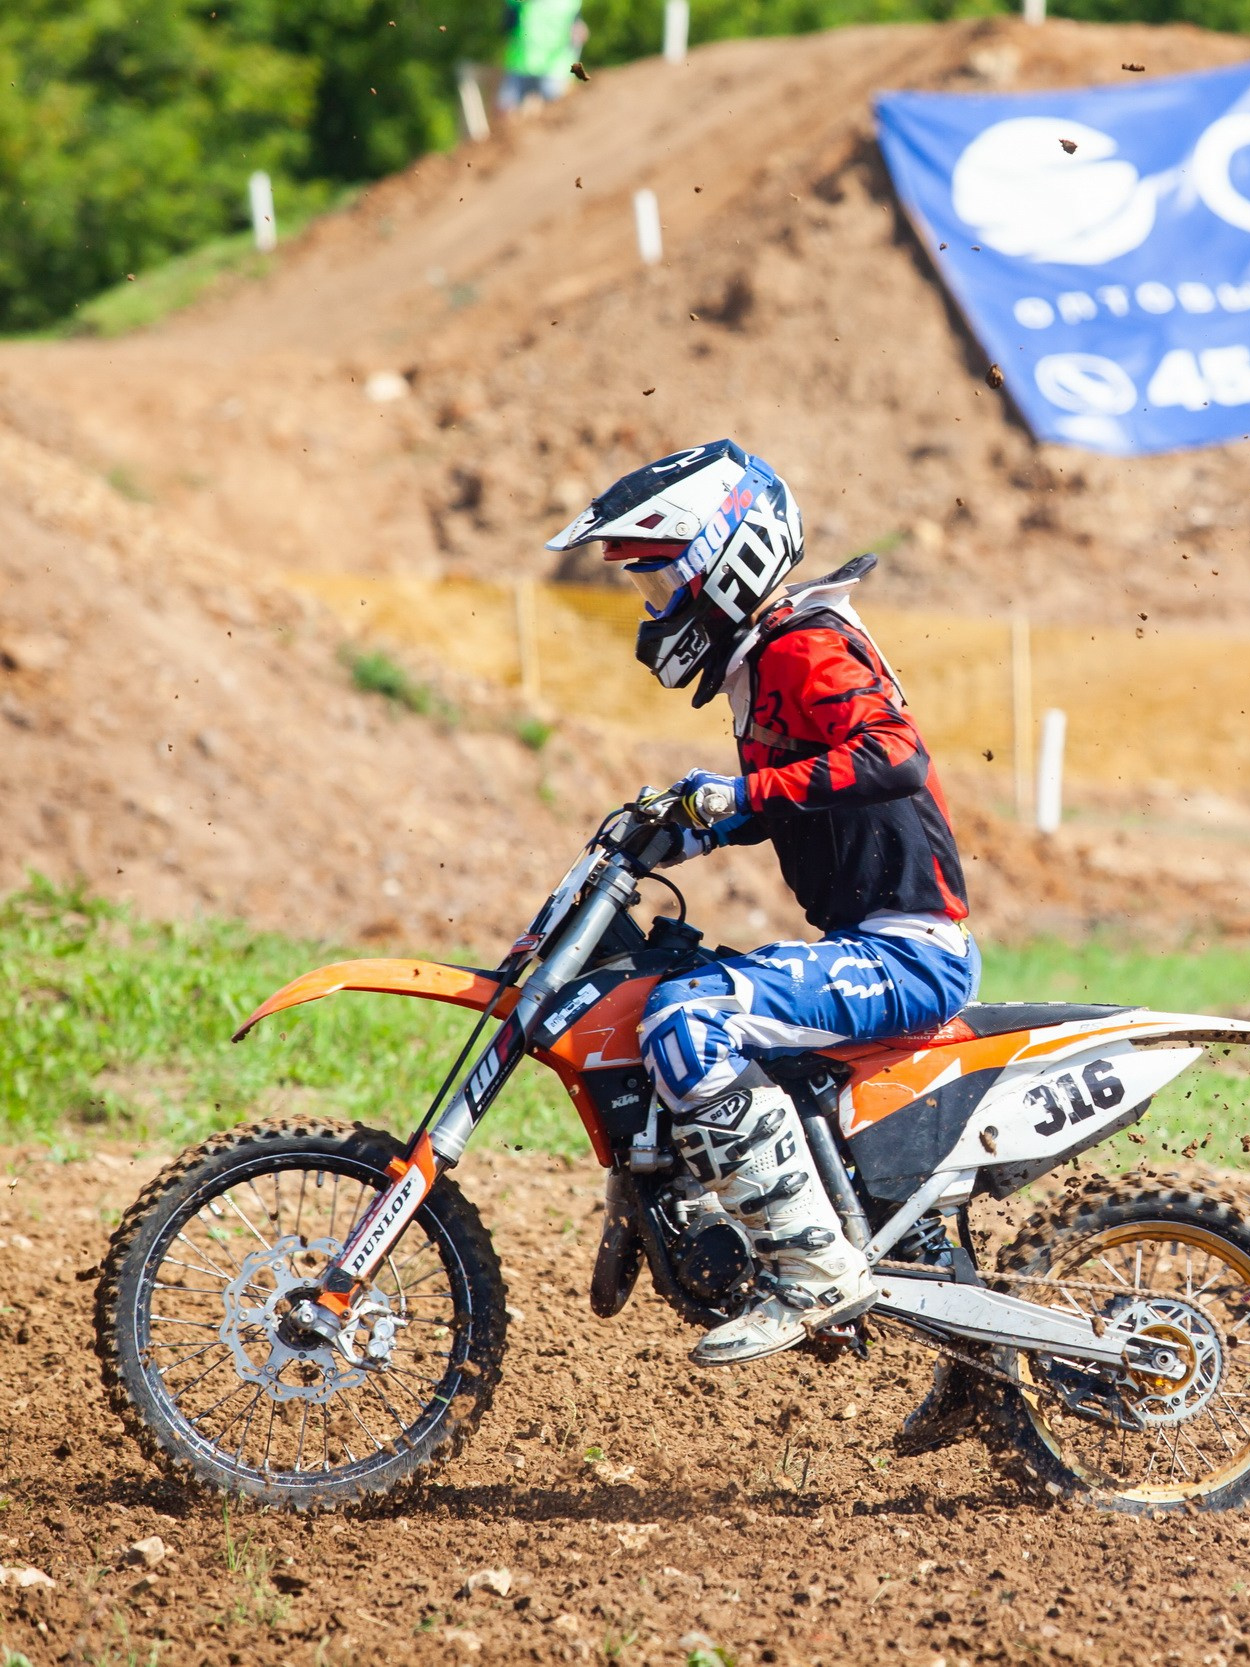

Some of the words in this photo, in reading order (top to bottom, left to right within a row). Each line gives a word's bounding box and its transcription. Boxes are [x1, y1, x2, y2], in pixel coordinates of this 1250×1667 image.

[678, 487, 753, 583] 100%
[703, 492, 789, 624] FOX
[611, 1094, 640, 1109] KTM
[1023, 1059, 1126, 1137] 316
[351, 1180, 412, 1272] DUNLOP
